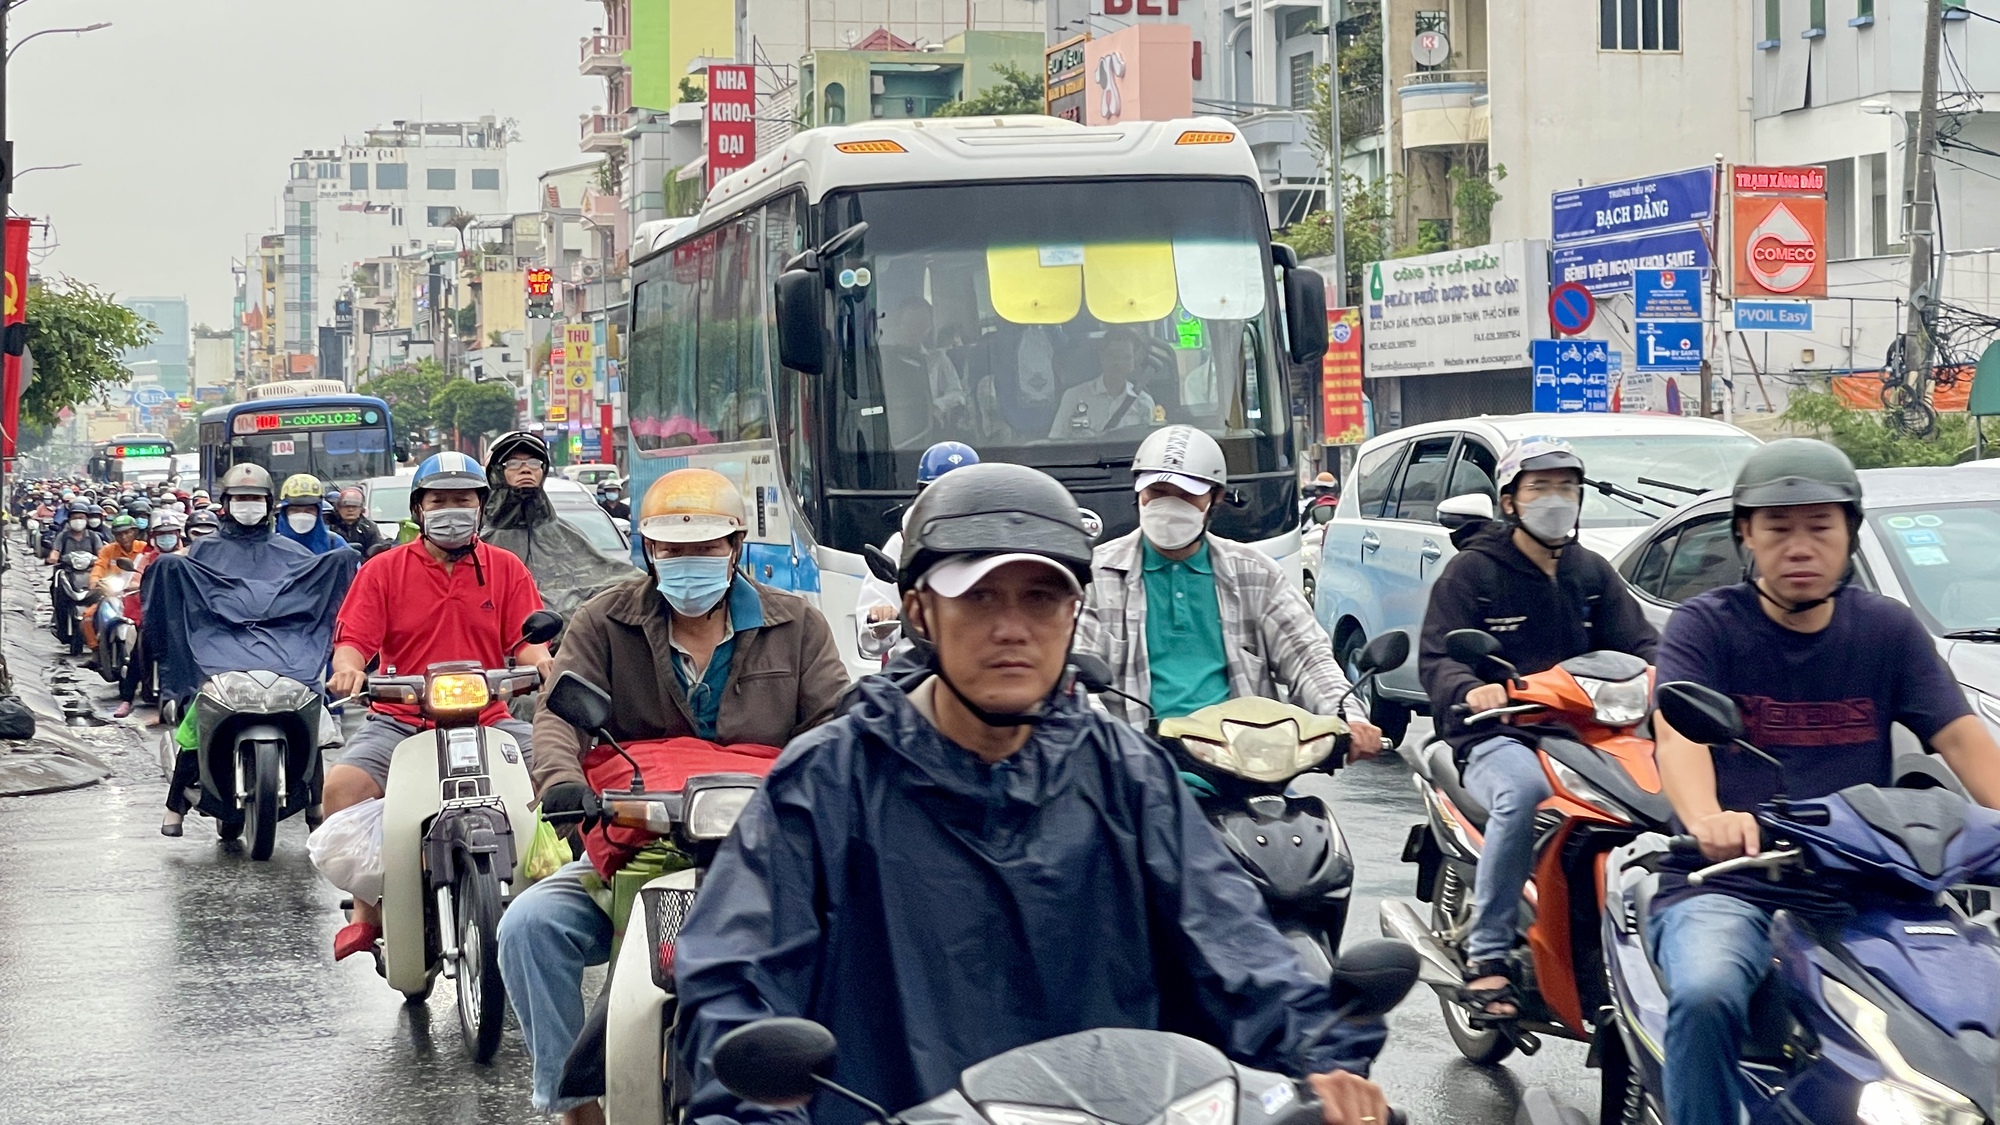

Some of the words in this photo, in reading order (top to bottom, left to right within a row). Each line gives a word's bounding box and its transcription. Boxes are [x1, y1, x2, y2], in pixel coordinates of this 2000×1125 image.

[716, 70, 748, 90] NHA
[712, 102, 752, 122] KHOA
[718, 135, 745, 158] ĐẠI
[1736, 173, 1768, 191] TRẠM
[1769, 171, 1800, 190] XĂNG
[1596, 204, 1631, 229] BẠCH
[1633, 195, 1669, 222] ĐẰNG
[1754, 248, 1817, 262] COMECO
[1393, 266, 1425, 282] CÔNG
[1428, 265, 1445, 277] TY
[1446, 255, 1463, 275] CỔ
[1464, 251, 1500, 272] PHẦN
[1564, 263, 1588, 282] BỆNH
[1589, 259, 1609, 281] VIỆN
[1639, 254, 1665, 268] KHOA
[1666, 250, 1696, 268] SANTE
[530, 271, 551, 283] BẾP
[1472, 277, 1492, 297] SÀI
[1494, 274, 1519, 295] GÒN
[533, 283, 548, 293] TỪ
[1738, 309, 1778, 322] PVOIL
[1779, 310, 1809, 325] Easy
[576, 346, 583, 358] Y
[293, 412, 326, 425] QUỐC
[327, 412, 342, 425] LỘ
[344, 413, 357, 423] 22
[272, 442, 293, 453] 104
